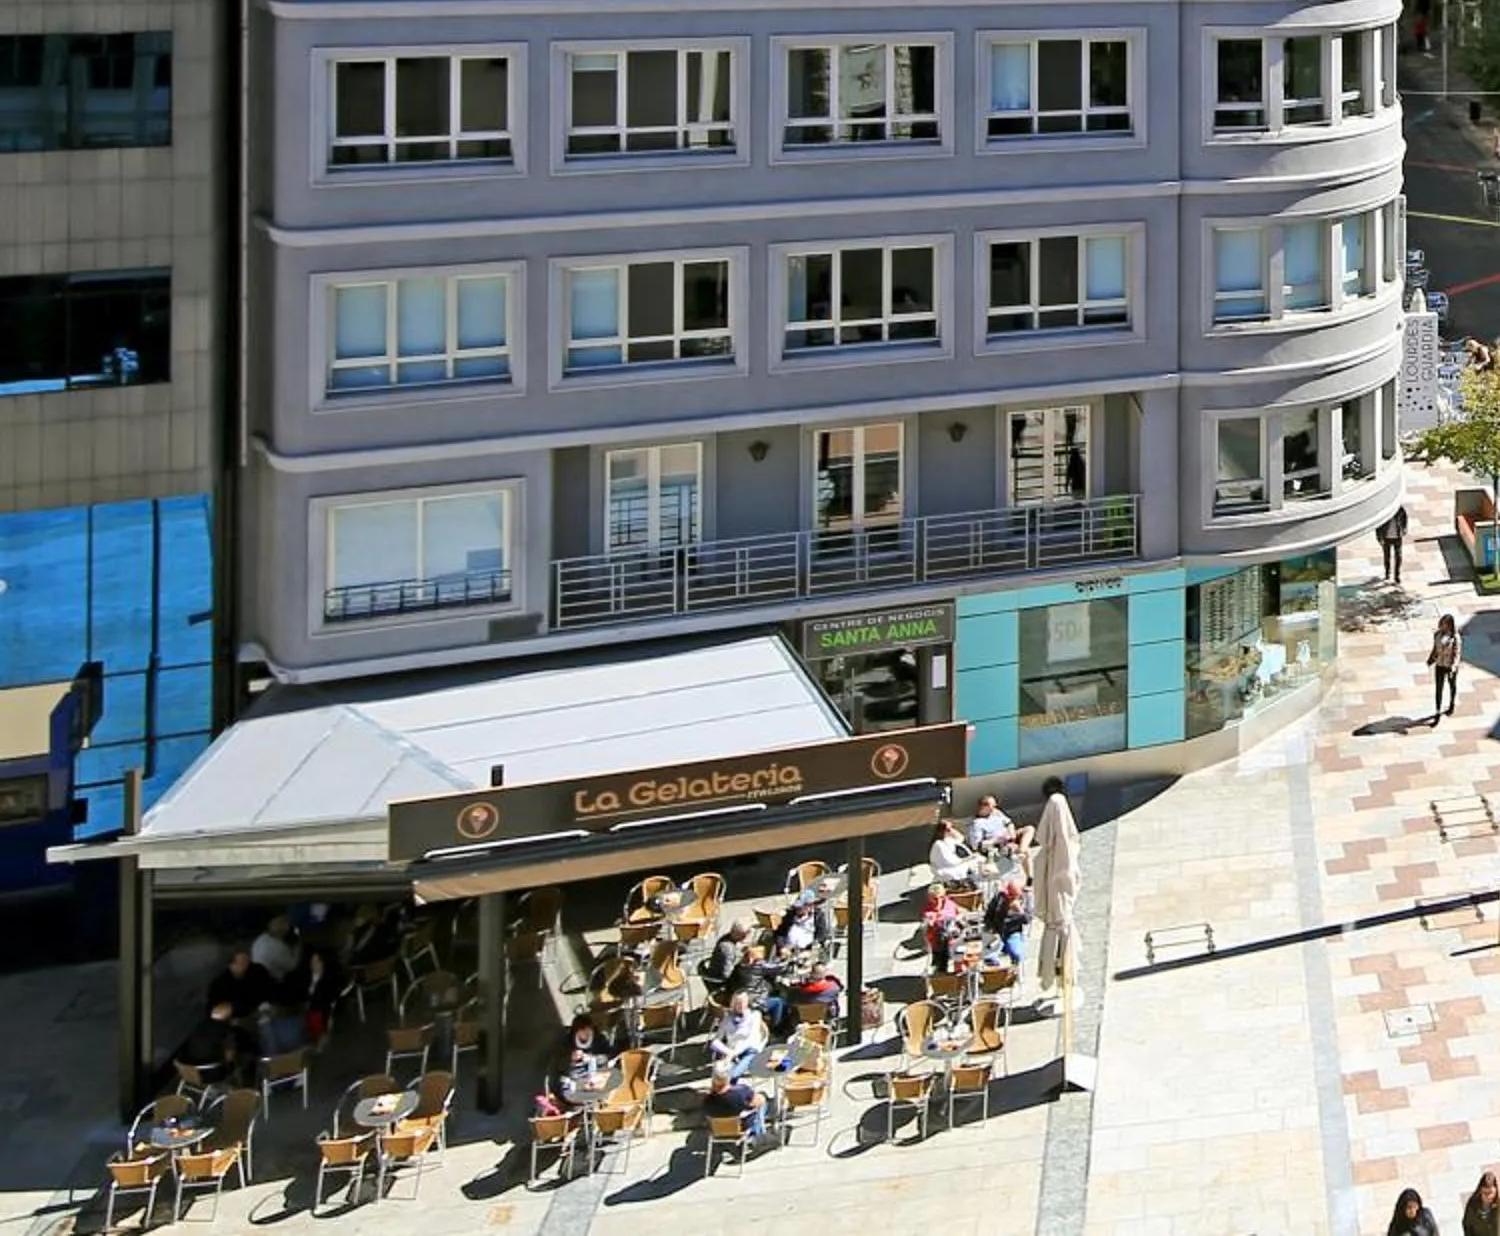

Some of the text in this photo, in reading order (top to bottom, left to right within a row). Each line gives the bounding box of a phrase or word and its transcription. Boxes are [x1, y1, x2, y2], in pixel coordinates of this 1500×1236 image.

[813, 608, 945, 632] CENTRE DE NEGOCIS
[819, 619, 937, 649] SANTA ANNA
[574, 763, 804, 814] La Gelateria
